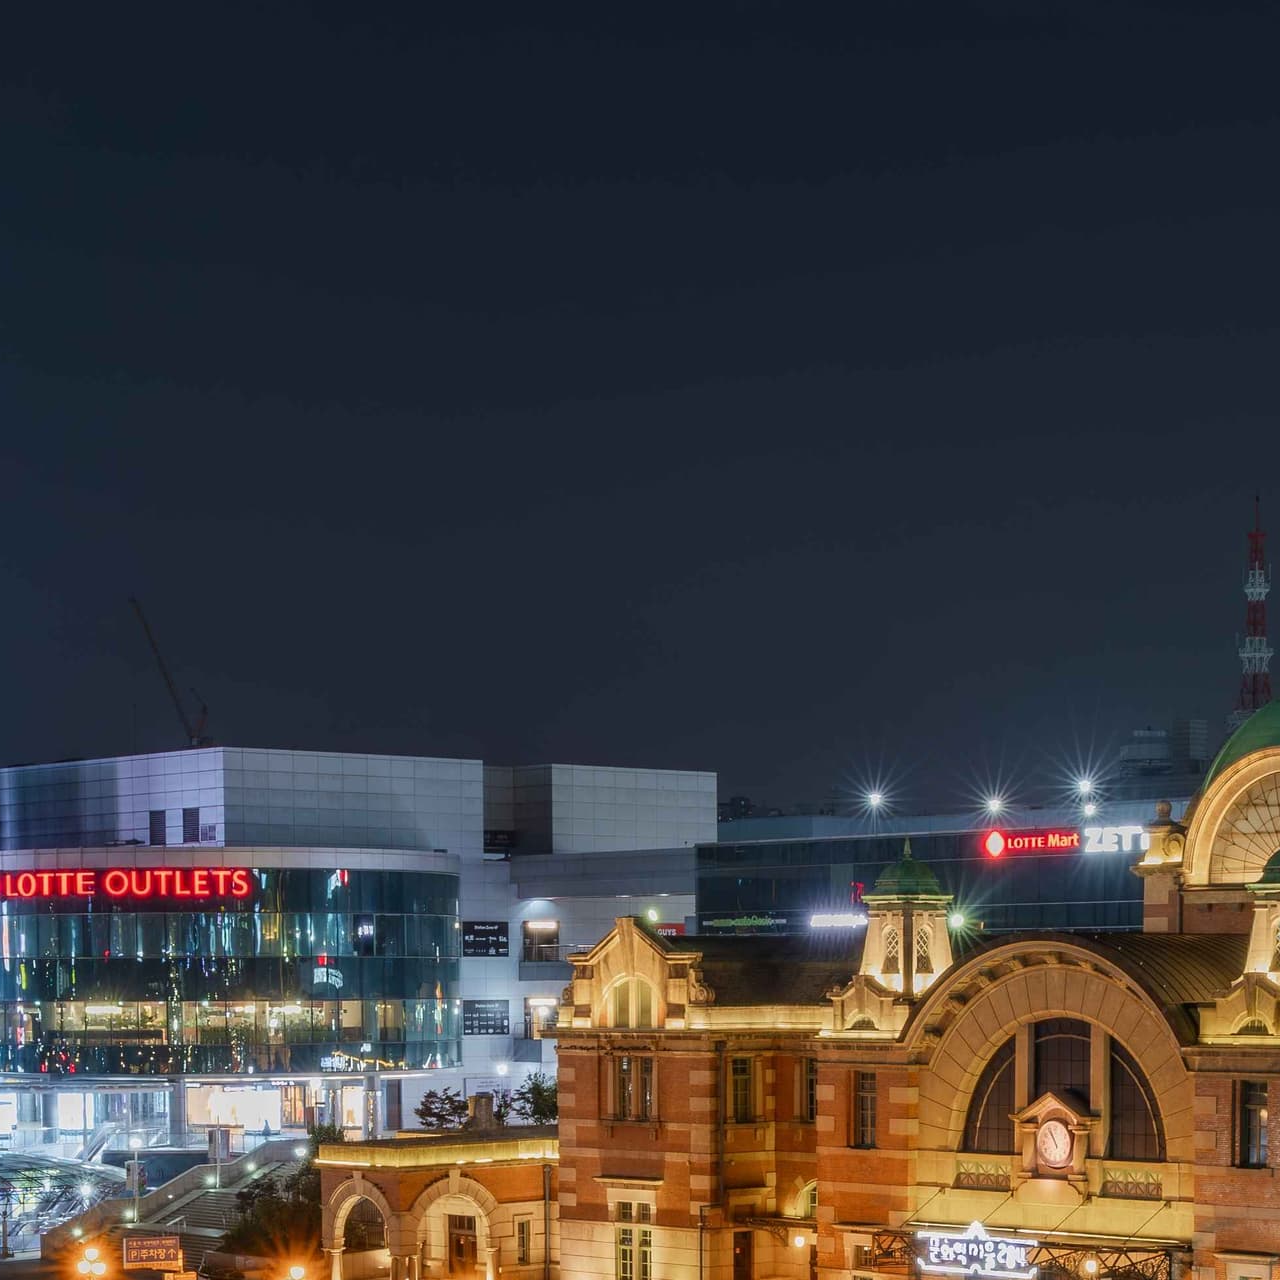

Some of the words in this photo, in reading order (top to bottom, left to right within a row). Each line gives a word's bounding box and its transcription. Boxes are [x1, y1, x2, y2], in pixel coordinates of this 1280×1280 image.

[1007, 836, 1045, 849] LOTTE
[1048, 832, 1080, 848] Mart
[5, 871, 96, 898] LOTTE
[105, 869, 250, 897] OUTLETS
[140, 1248, 167, 1261] 주차장
